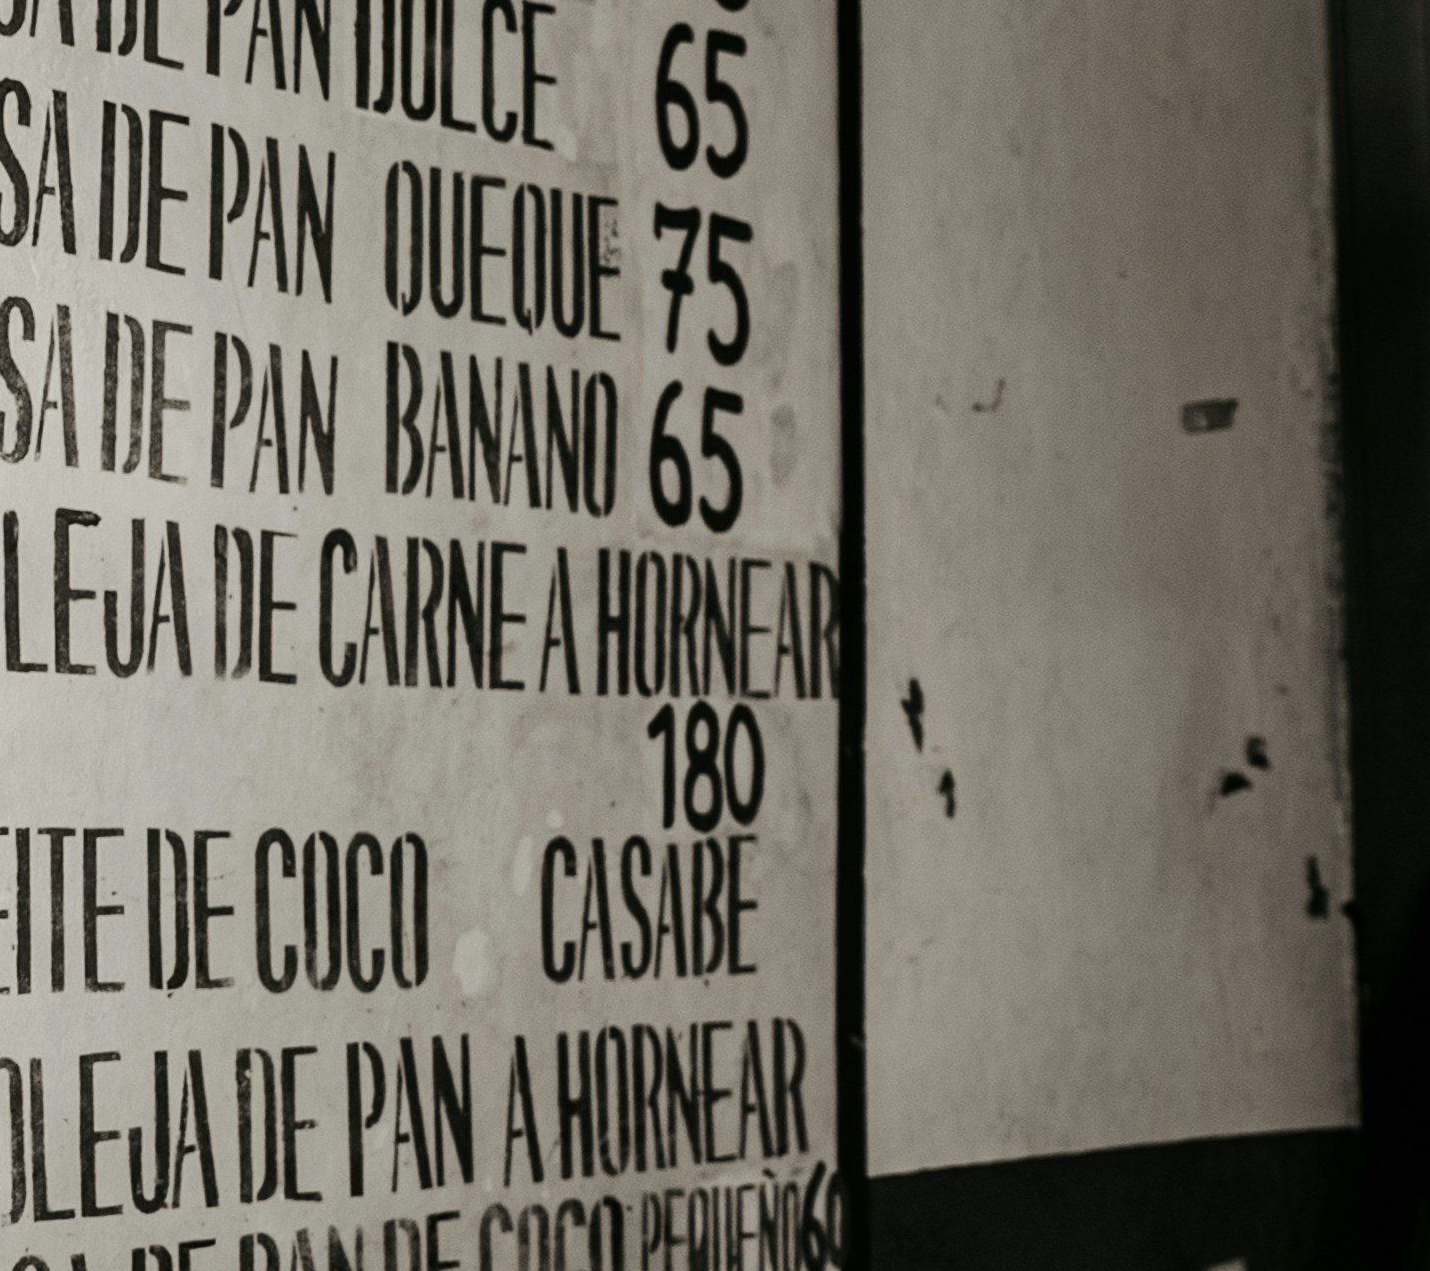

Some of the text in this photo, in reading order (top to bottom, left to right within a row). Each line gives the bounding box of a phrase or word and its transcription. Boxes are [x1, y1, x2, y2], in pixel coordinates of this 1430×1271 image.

[655, 22, 750, 180] 65
[98, 99, 191, 276] DE
[209, 121, 337, 304] PAN
[384, 159, 622, 342] QUEQUE
[652, 201, 754, 367] 75
[100, 309, 194, 486] DE
[210, 330, 339, 497] PAN
[385, 340, 619, 519] BANANO
[648, 379, 745, 534] 65
[213, 523, 300, 686] DE
[319, 527, 528, 691] CARNE
[538, 545, 582, 696] A
[596, 545, 841, 702] HORNEAR
[646, 699, 766, 834] 180
[146, 826, 236, 992] DE
[254, 826, 429, 994] COCO
[540, 833, 760, 984] CASABE
[234, 1045, 323, 1204] DE
[346, 1031, 475, 1198] PAN
[504, 1034, 545, 1189] A
[557, 1016, 810, 1181] HORNEAR
